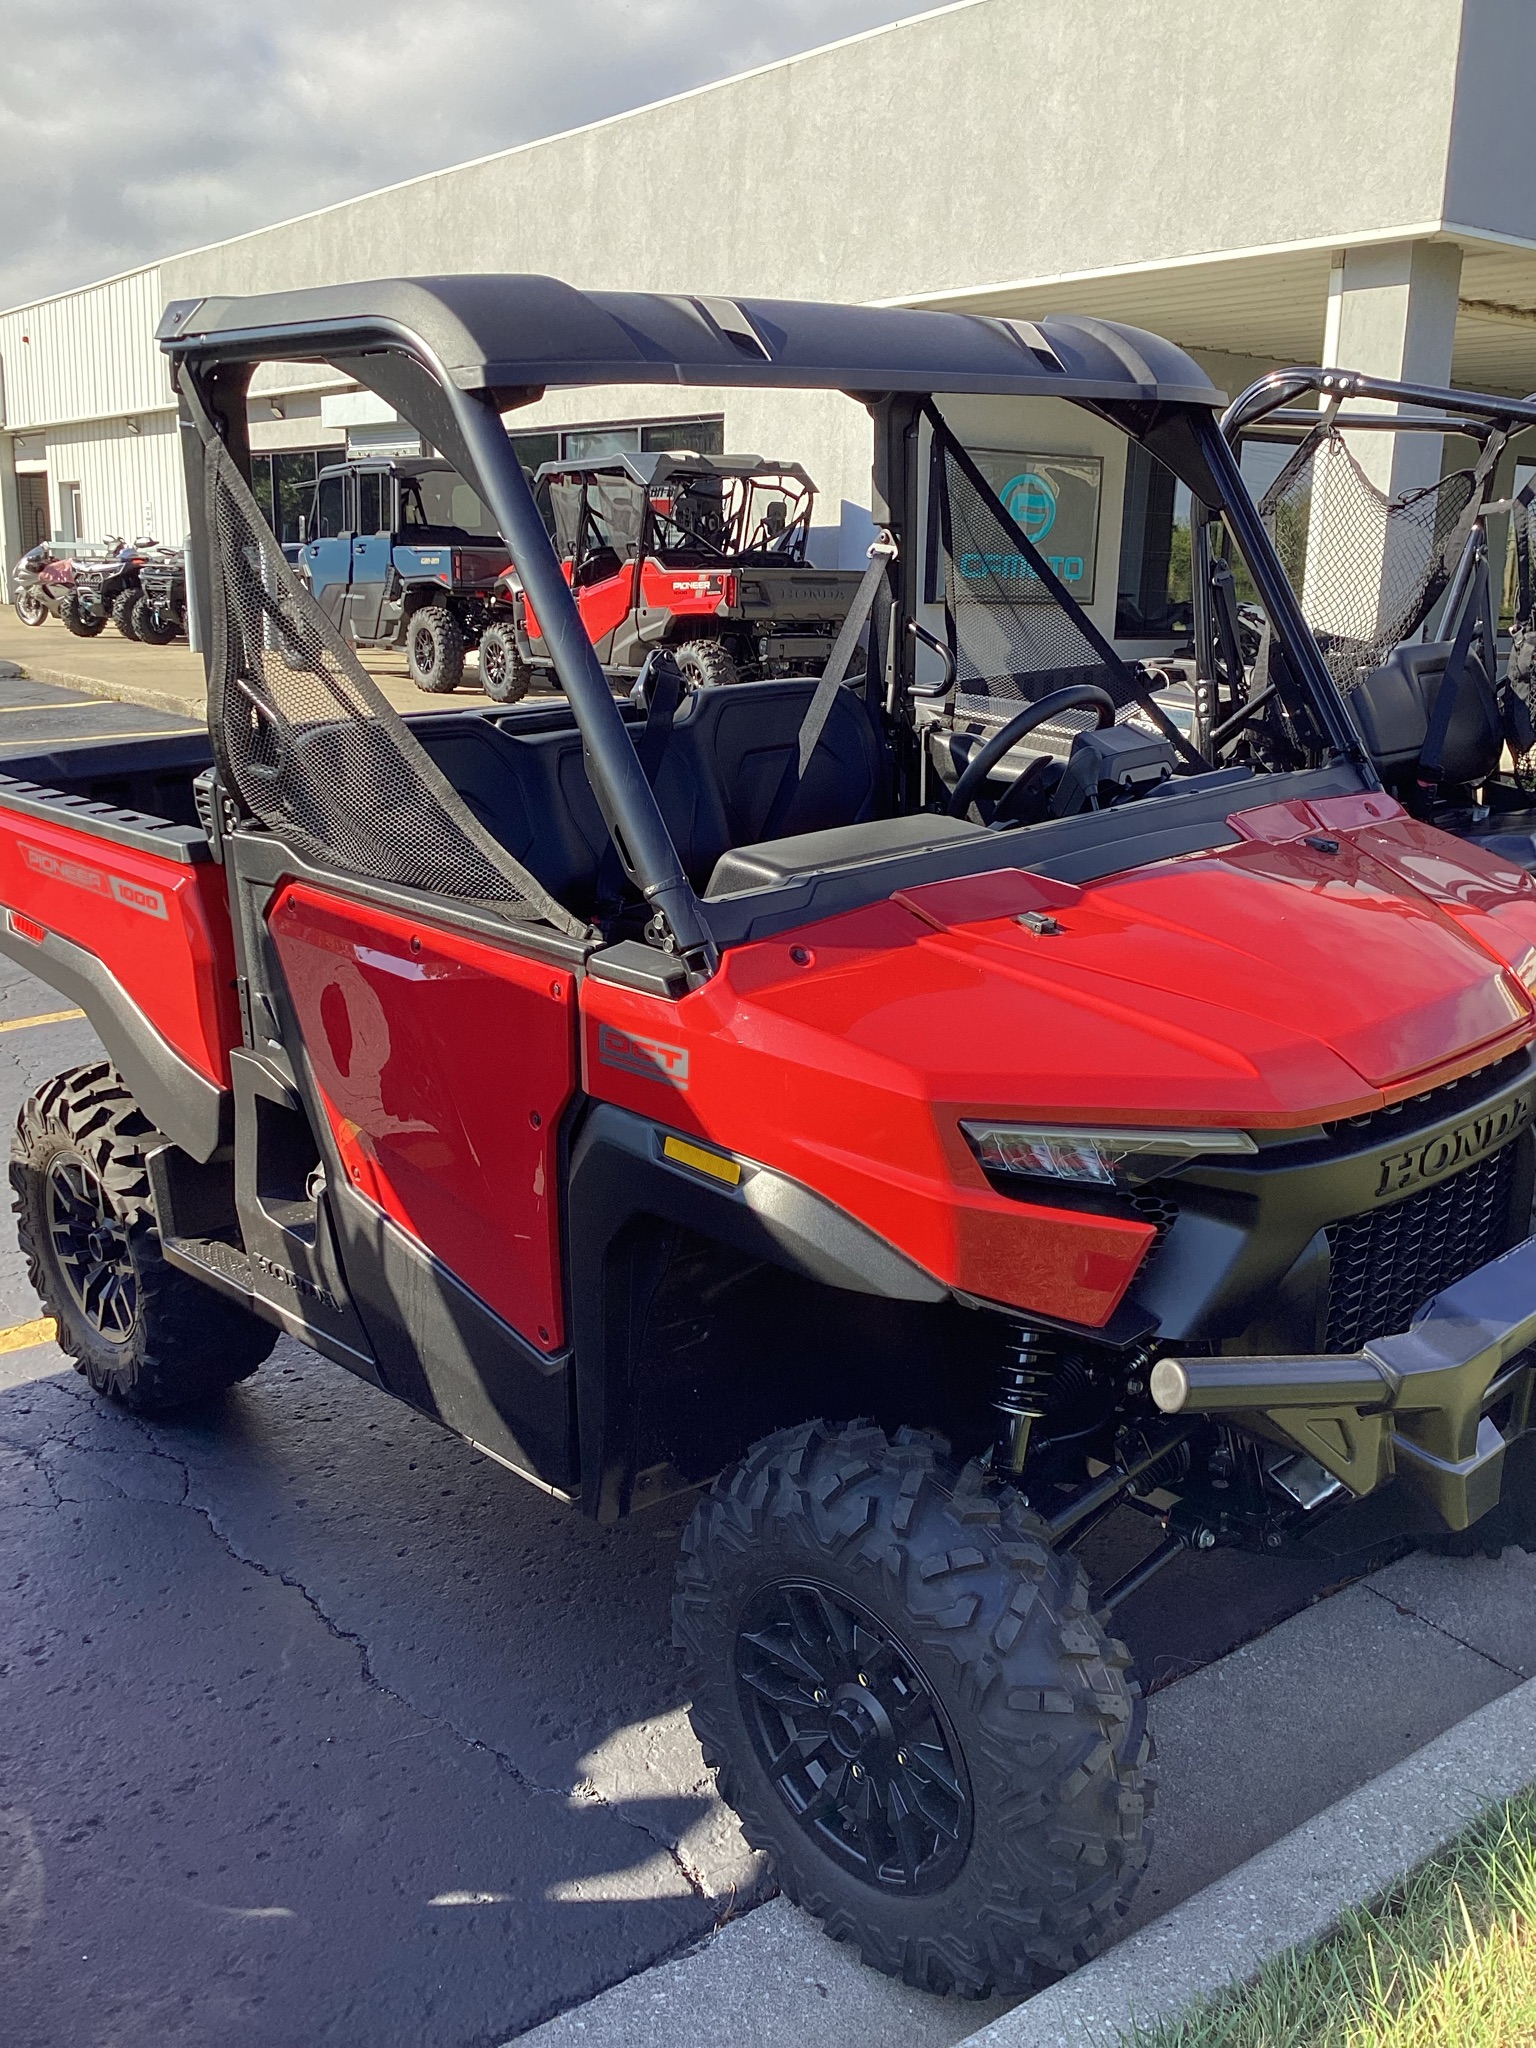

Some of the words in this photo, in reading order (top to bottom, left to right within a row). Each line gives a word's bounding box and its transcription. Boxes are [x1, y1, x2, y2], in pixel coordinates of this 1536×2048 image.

[672, 581, 711, 591] PIONEER
[960, 553, 1084, 580] CFMTO
[782, 587, 845, 601] HONDA
[27, 848, 102, 889] PIONEER
[118, 883, 159, 911] 1000
[604, 1030, 683, 1070] DCT
[1374, 1091, 1532, 1197] HONDA
[252, 1250, 344, 1315] HONDA
